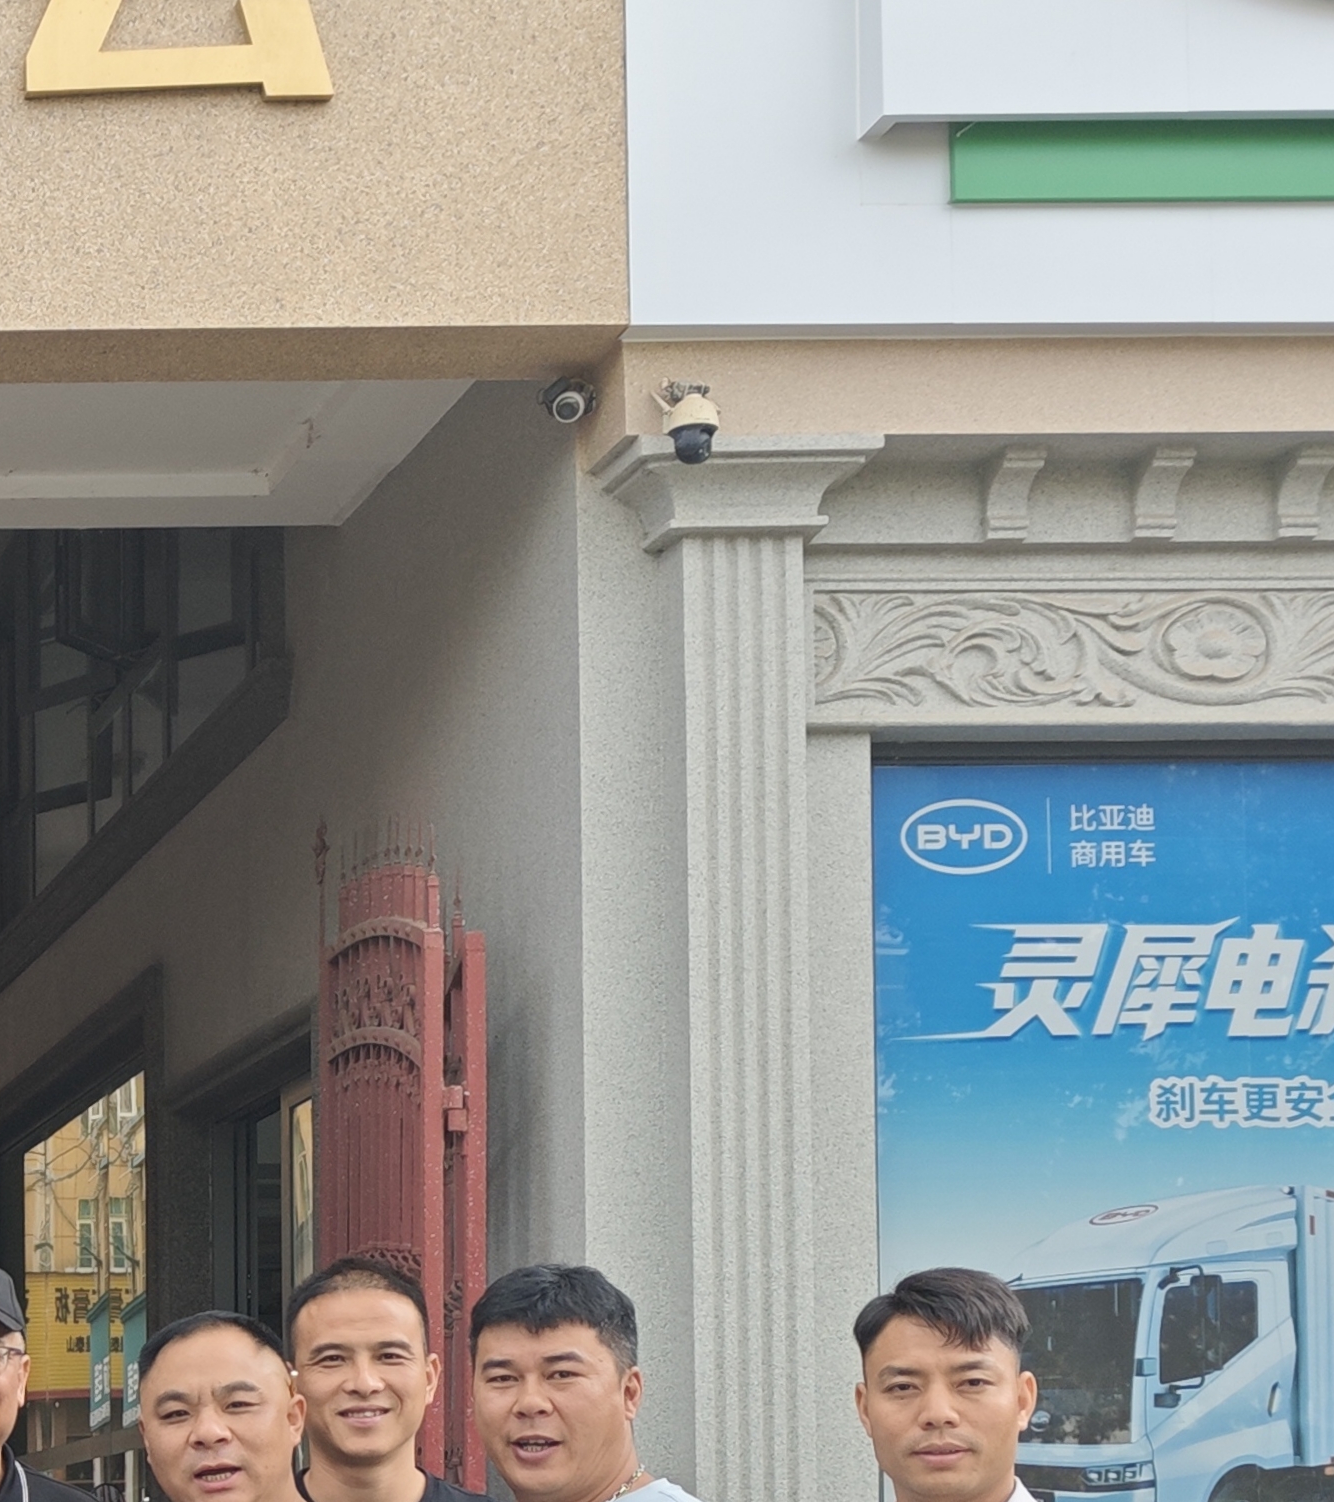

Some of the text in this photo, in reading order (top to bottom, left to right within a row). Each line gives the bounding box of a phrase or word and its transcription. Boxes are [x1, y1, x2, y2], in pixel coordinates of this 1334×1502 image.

[1070, 803, 1156, 832] 比亚迪
[917, 823, 1013, 850] BYD
[1070, 840, 1157, 868] 商用车
[1154, 1082, 1334, 1123] 刹车更安
